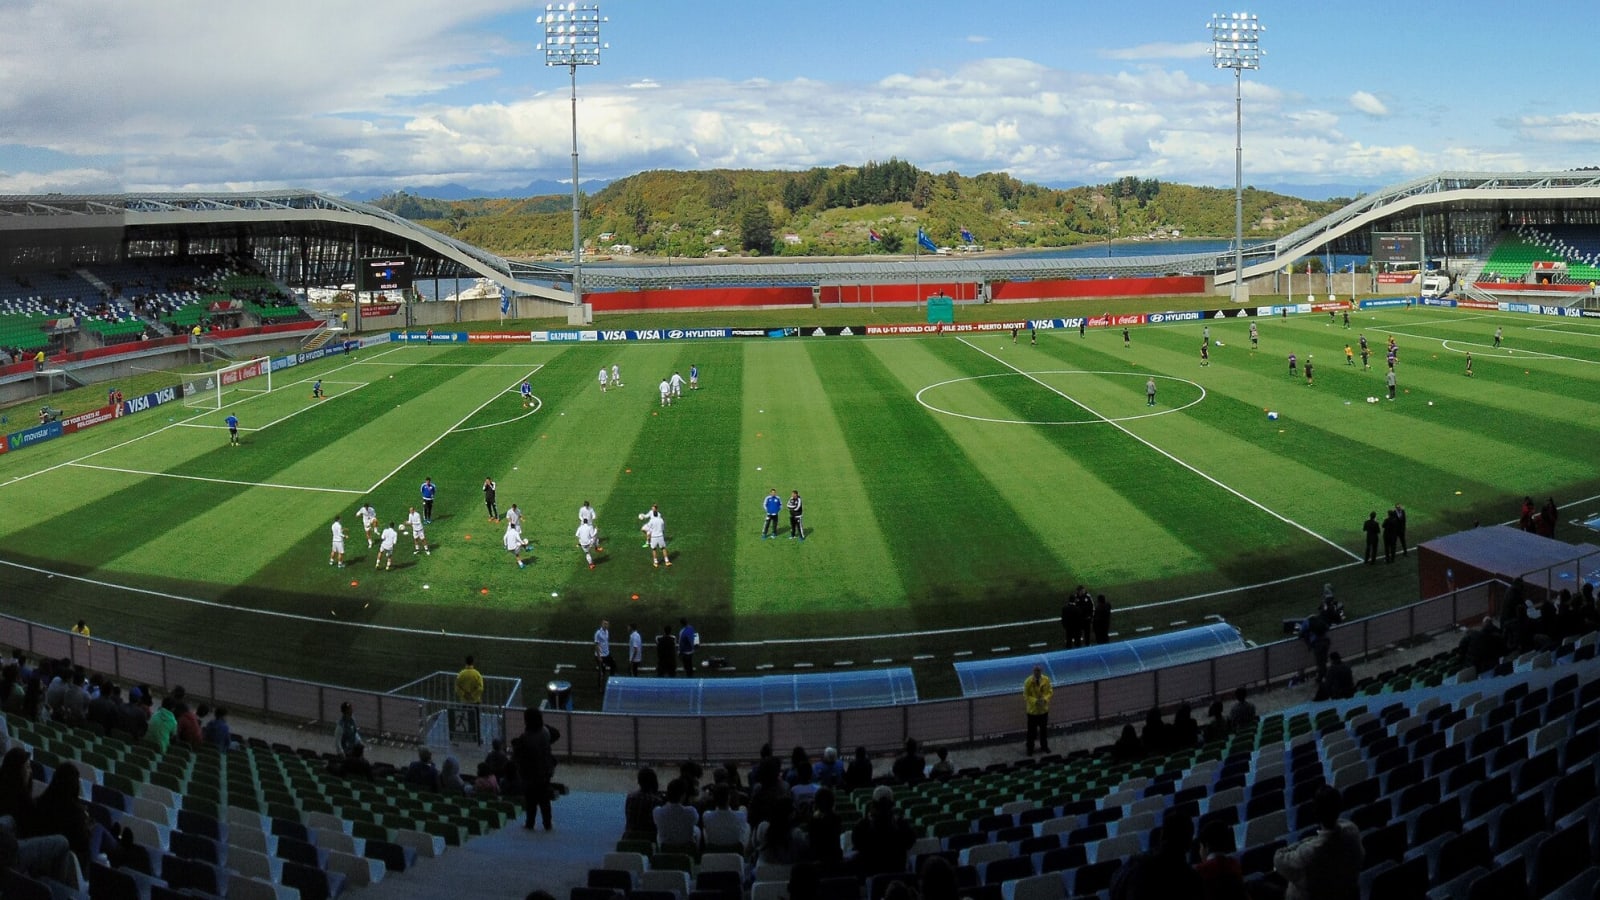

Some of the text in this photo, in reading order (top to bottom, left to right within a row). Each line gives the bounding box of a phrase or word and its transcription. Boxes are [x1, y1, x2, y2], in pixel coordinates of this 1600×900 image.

[1542, 306, 1559, 316] VISA
[1563, 307, 1581, 317] VISA
[1118, 315, 1139, 325] Coca-Cola
[1165, 312, 1199, 321] HYUNDAI
[1030, 320, 1055, 329] VISA
[600, 330, 627, 340] VISA
[633, 330, 661, 340] VISA
[685, 330, 726, 338] HYUNDAI
[154, 387, 175, 405] VISA
[127, 395, 150, 413] VISA
[23, 428, 49, 443] movistar
